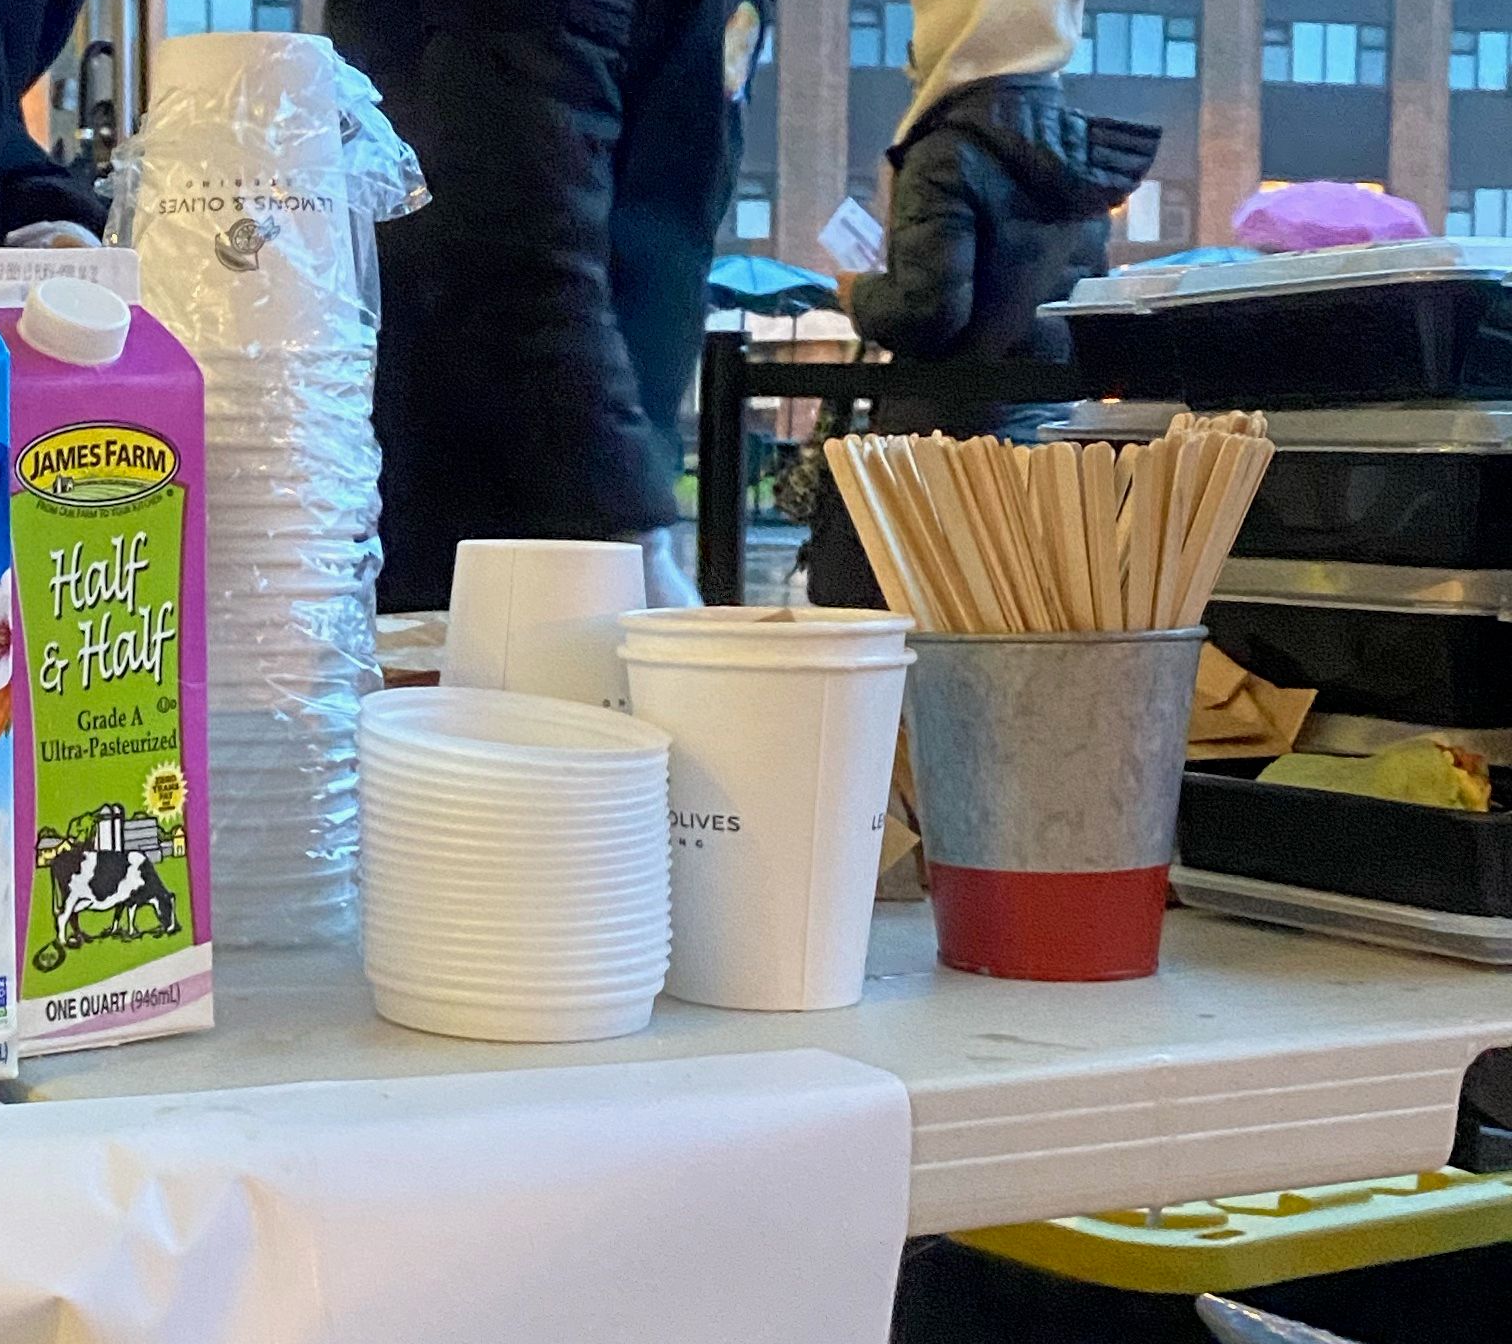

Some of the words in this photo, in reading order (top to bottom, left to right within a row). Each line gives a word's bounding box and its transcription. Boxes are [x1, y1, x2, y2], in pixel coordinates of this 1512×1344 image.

[159, 197, 225, 214] OLIVES
[232, 197, 246, 212] &
[254, 196, 334, 213] LEMONS
[30, 443, 101, 480] JAMES
[104, 439, 166, 473] FARM
[49, 530, 150, 620] Half
[40, 641, 70, 695] &
[78, 600, 177, 690] Half
[78, 707, 127, 731] Grade
[130, 705, 144, 726] A
[41, 728, 178, 763] Ultra-Pasteurized
[669, 810, 741, 833] OLIVES
[46, 999, 78, 1023] ONE
[80, 993, 127, 1020] QUART
